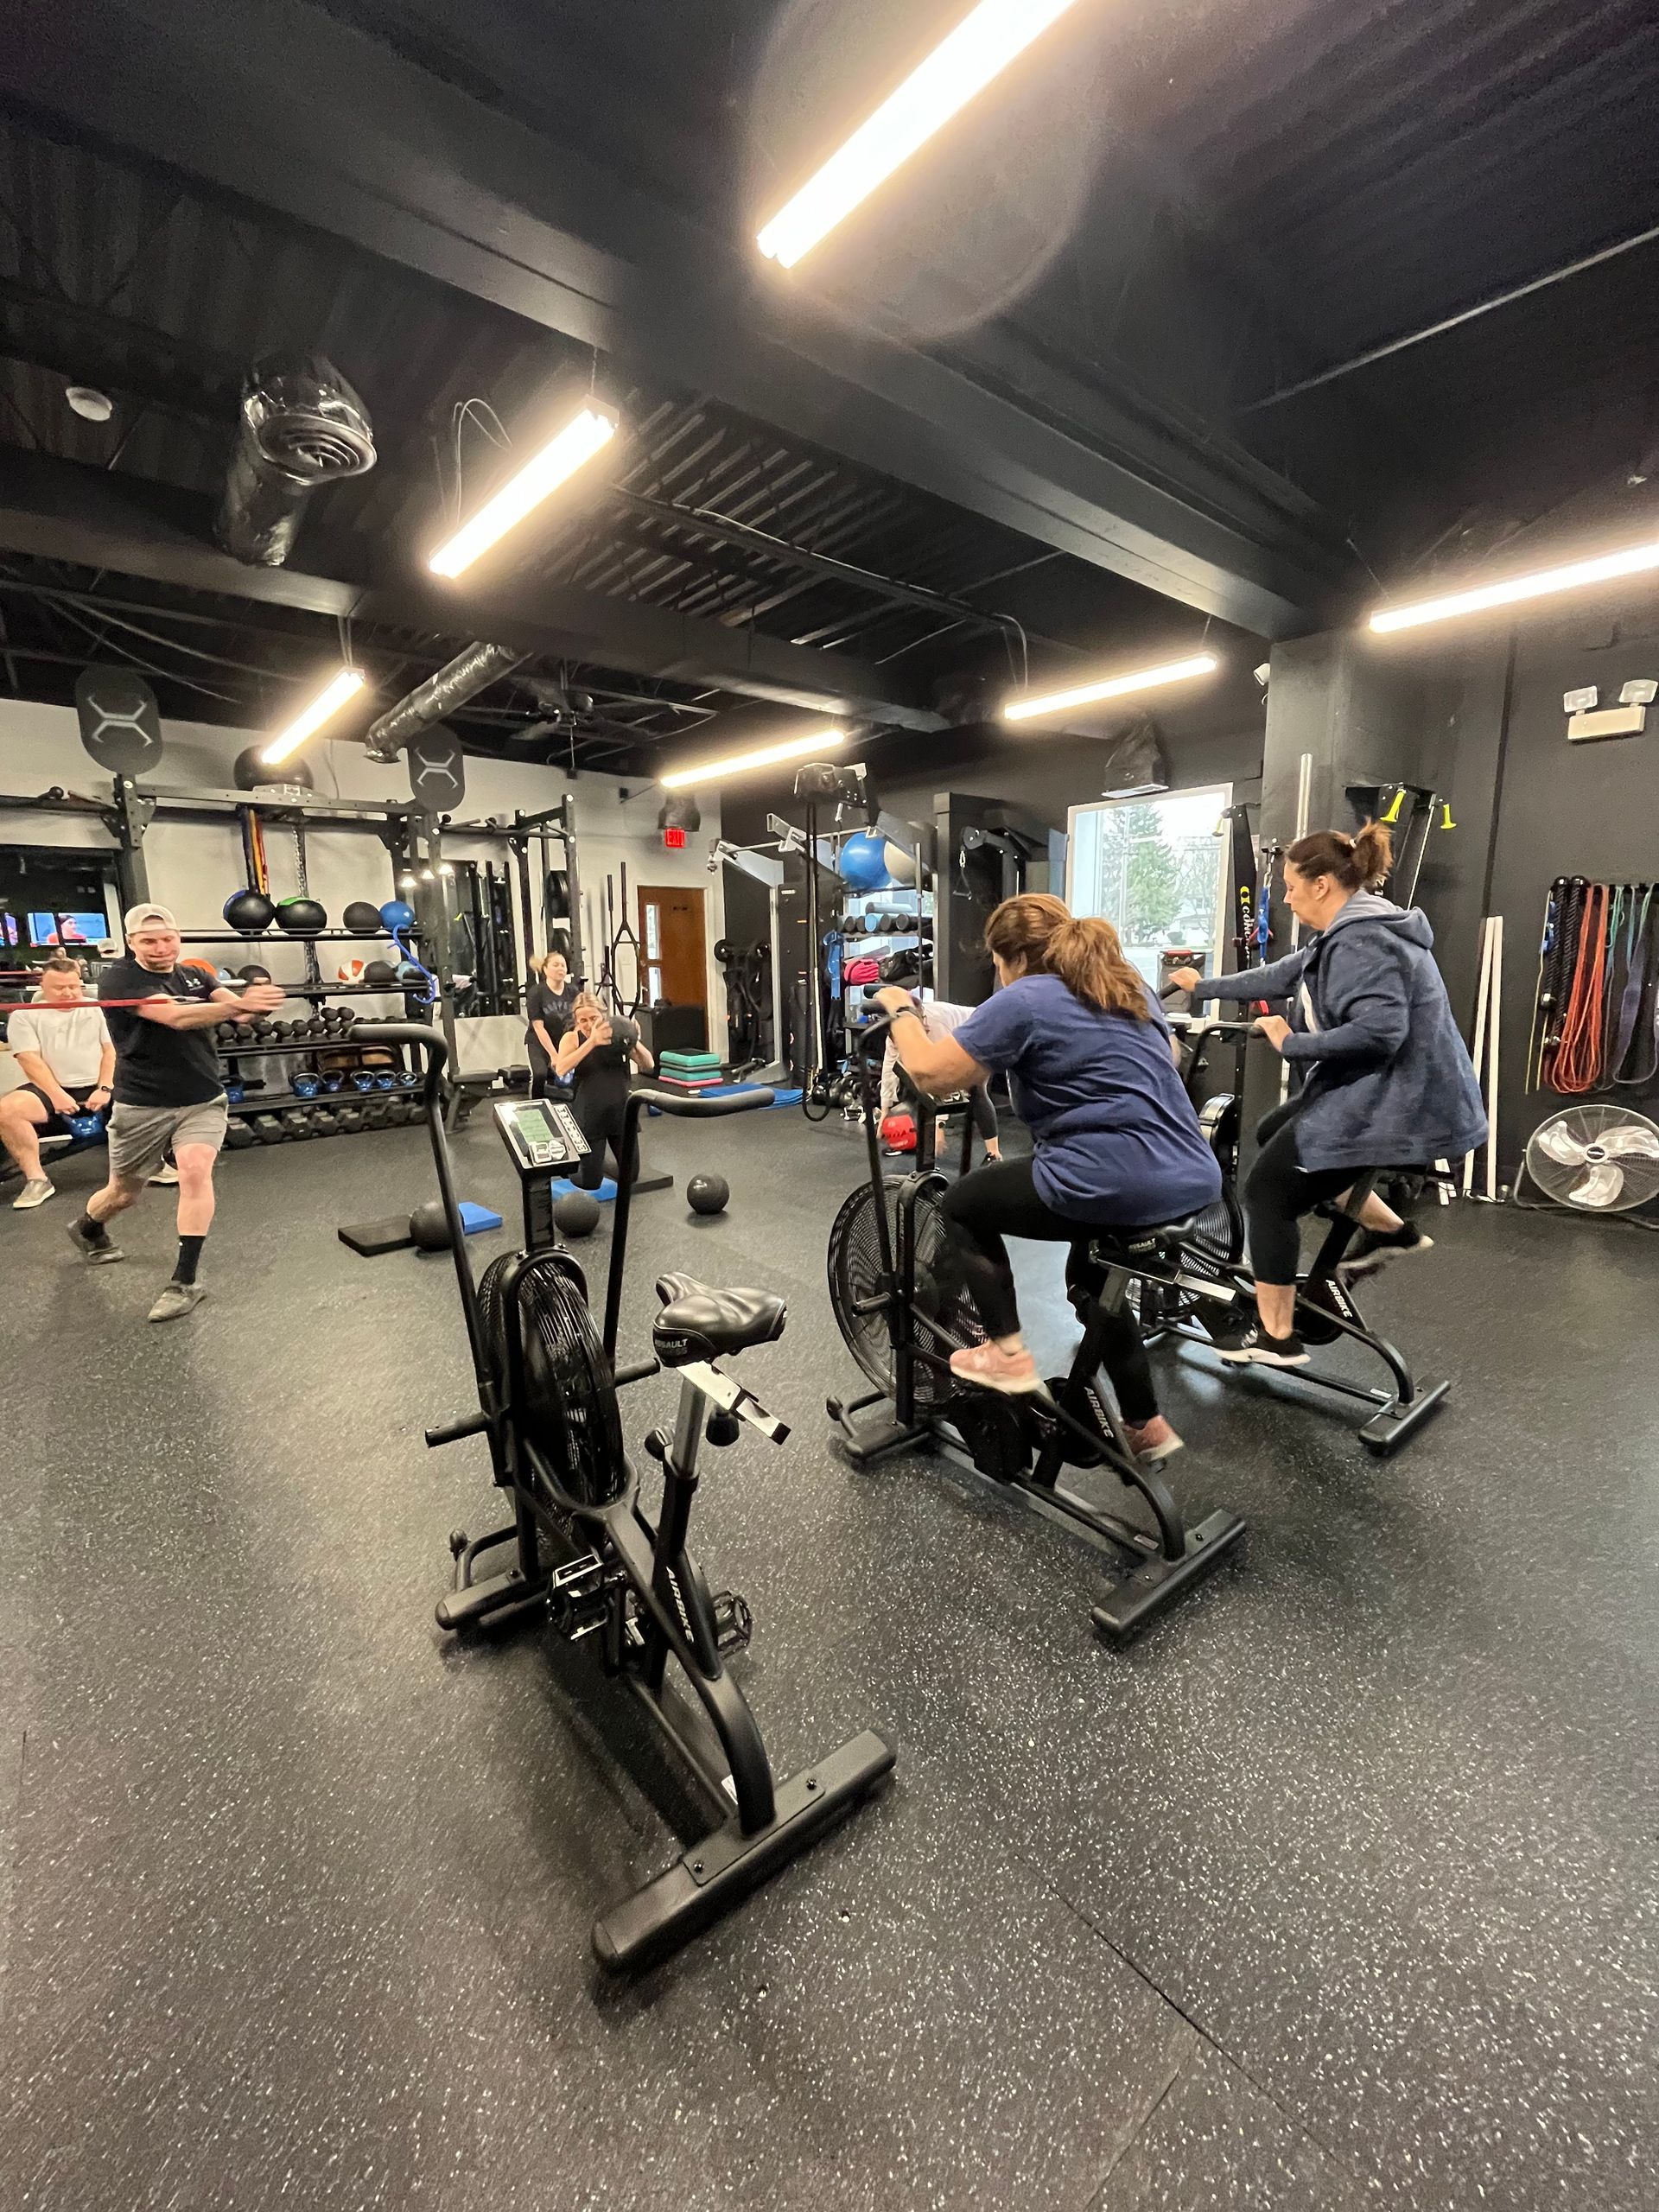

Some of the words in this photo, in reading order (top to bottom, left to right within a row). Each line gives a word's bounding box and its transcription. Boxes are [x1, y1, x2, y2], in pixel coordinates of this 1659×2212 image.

[666, 829, 685, 846] EXIT
[1325, 1279, 1353, 1318] AIRBIKE
[1084, 1386, 1115, 1438] AIRBIKE
[665, 1566, 695, 1643] AIRBIKE
